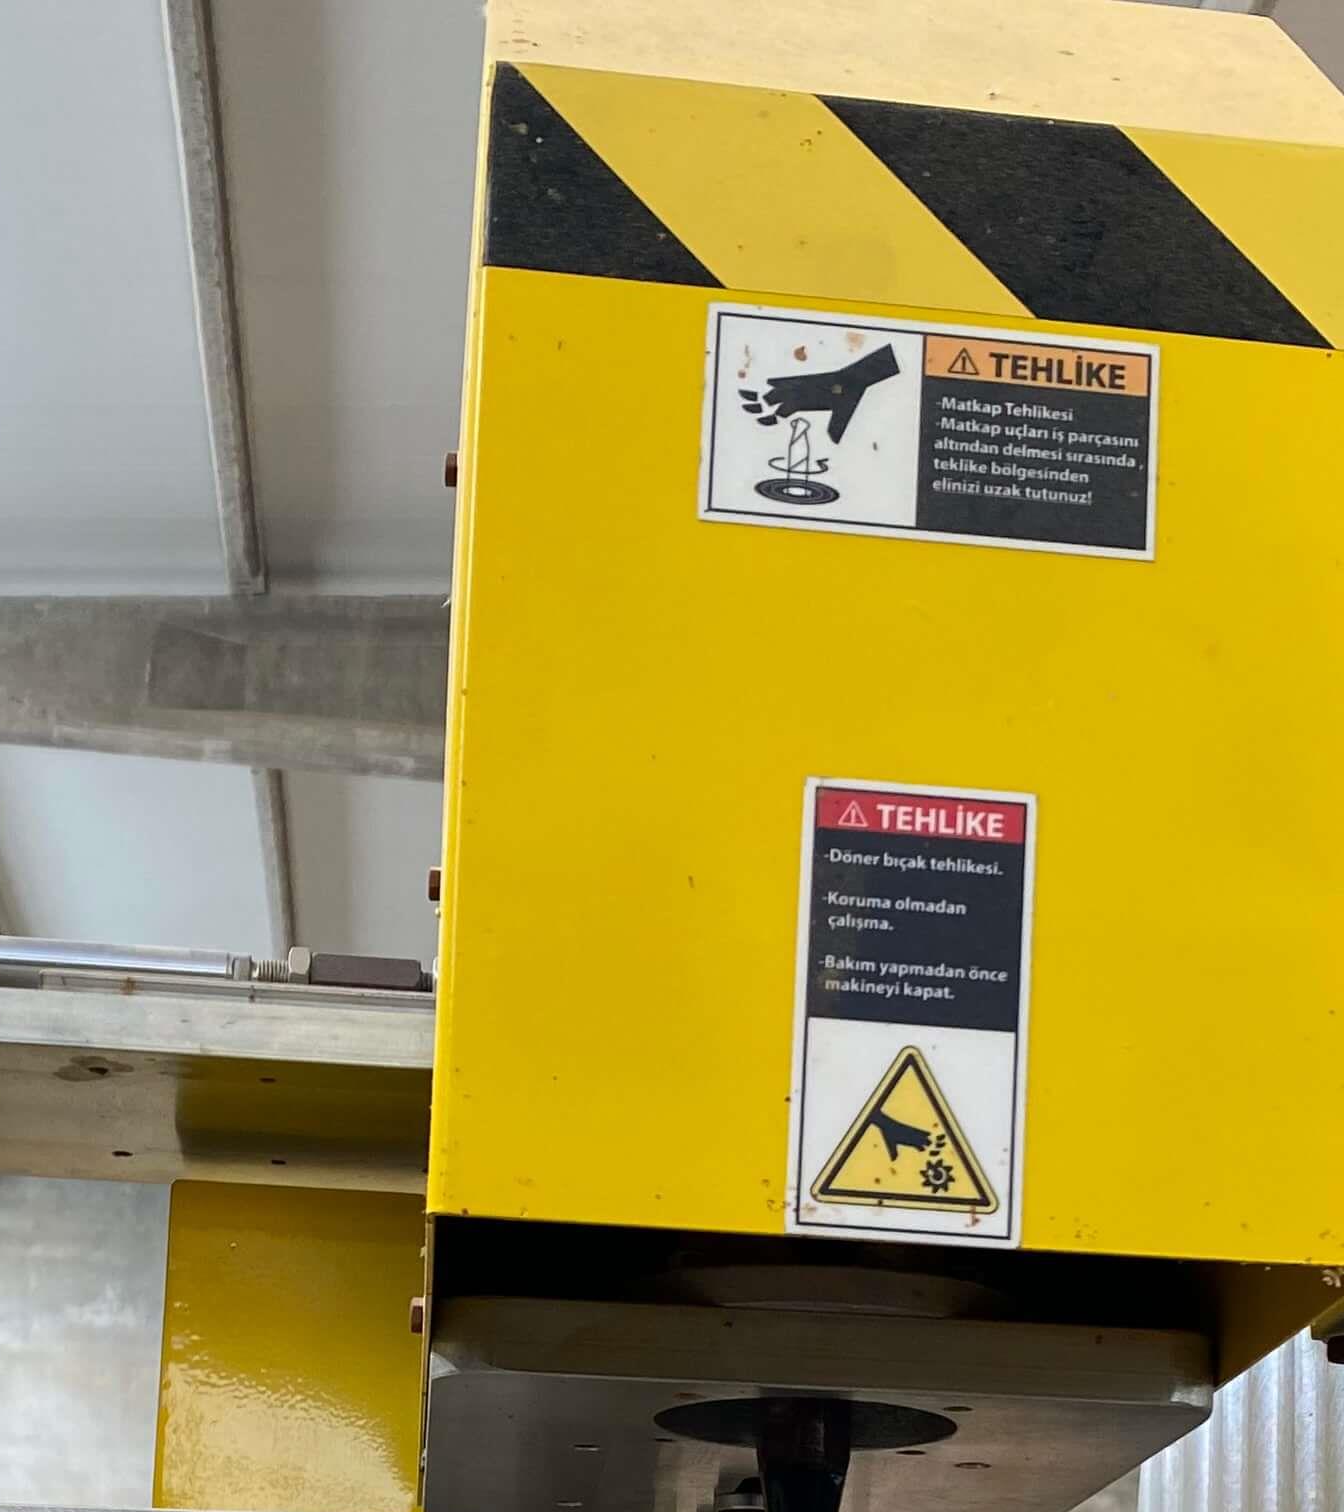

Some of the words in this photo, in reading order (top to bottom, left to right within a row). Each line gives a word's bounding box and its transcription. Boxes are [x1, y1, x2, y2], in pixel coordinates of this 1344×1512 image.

[990, 351, 1126, 390] TEHLİKE
[1005, 402, 1074, 421] Tehlikesi
[1005, 424, 1048, 440] uçları
[1052, 427, 1064, 442] iş
[1068, 429, 1139, 448] parçasını
[934, 437, 999, 455] altından
[1003, 443, 1062, 460] delmesi
[991, 461, 1090, 483] bölgesinden
[932, 478, 980, 493] elinizi
[984, 483, 1021, 497] uzak
[1025, 486, 1092, 505] tutunuz!
[877, 803, 1005, 839] TEHLİKE
[883, 853, 926, 871] bıçak
[930, 858, 1004, 876] tehlikesi.
[895, 897, 966, 915] olmadan
[827, 913, 895, 931] çalışma.
[879, 960, 965, 979] yapmadan
[968, 967, 1008, 982] önce
[825, 978, 900, 995] makineyi
[903, 982, 955, 1001] kapat.
